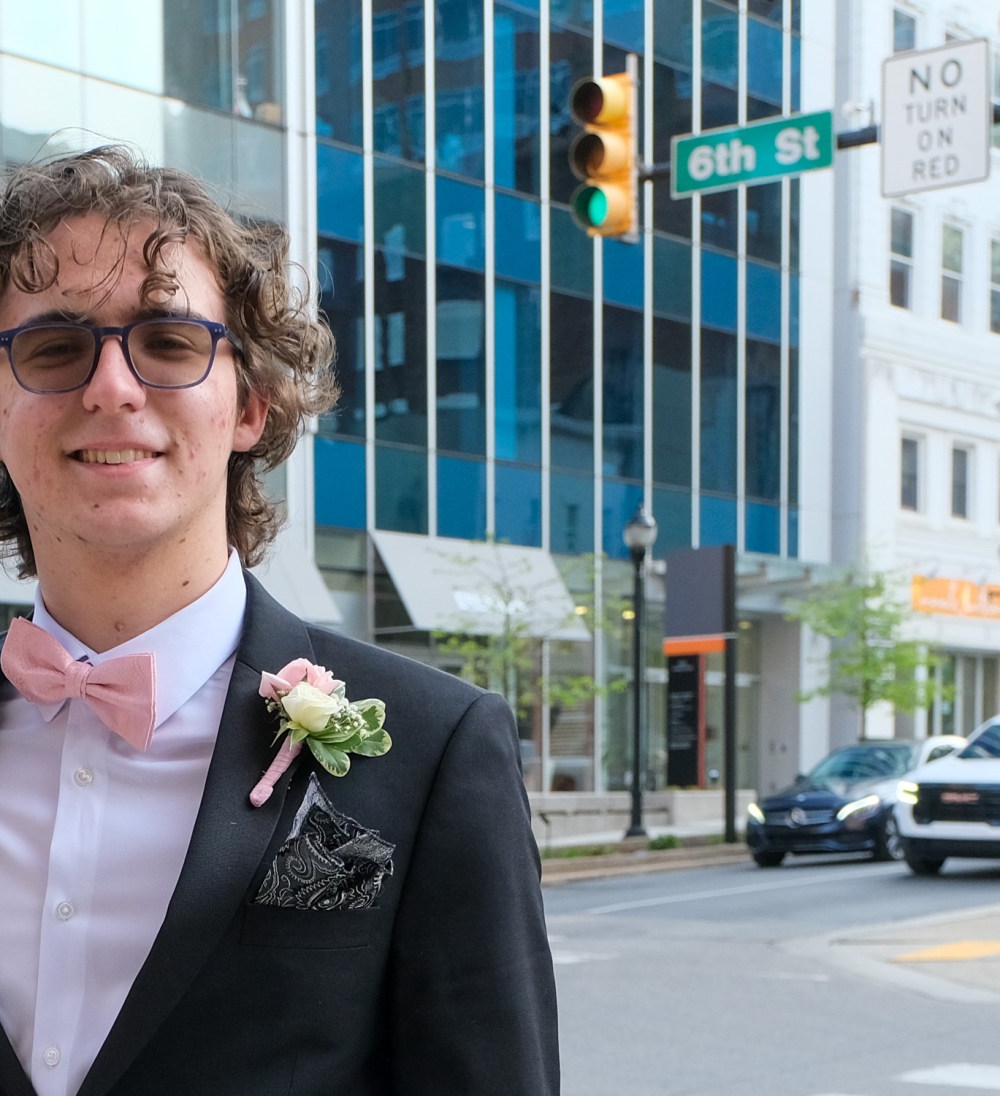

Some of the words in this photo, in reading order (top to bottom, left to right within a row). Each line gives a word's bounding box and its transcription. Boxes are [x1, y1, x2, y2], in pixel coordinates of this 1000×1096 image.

[910, 58, 963, 95] NO
[904, 95, 968, 126] TURN
[687, 138, 757, 182] 6th
[774, 124, 821, 167] St
[916, 128, 953, 154] ON
[911, 153, 960, 183] RED
